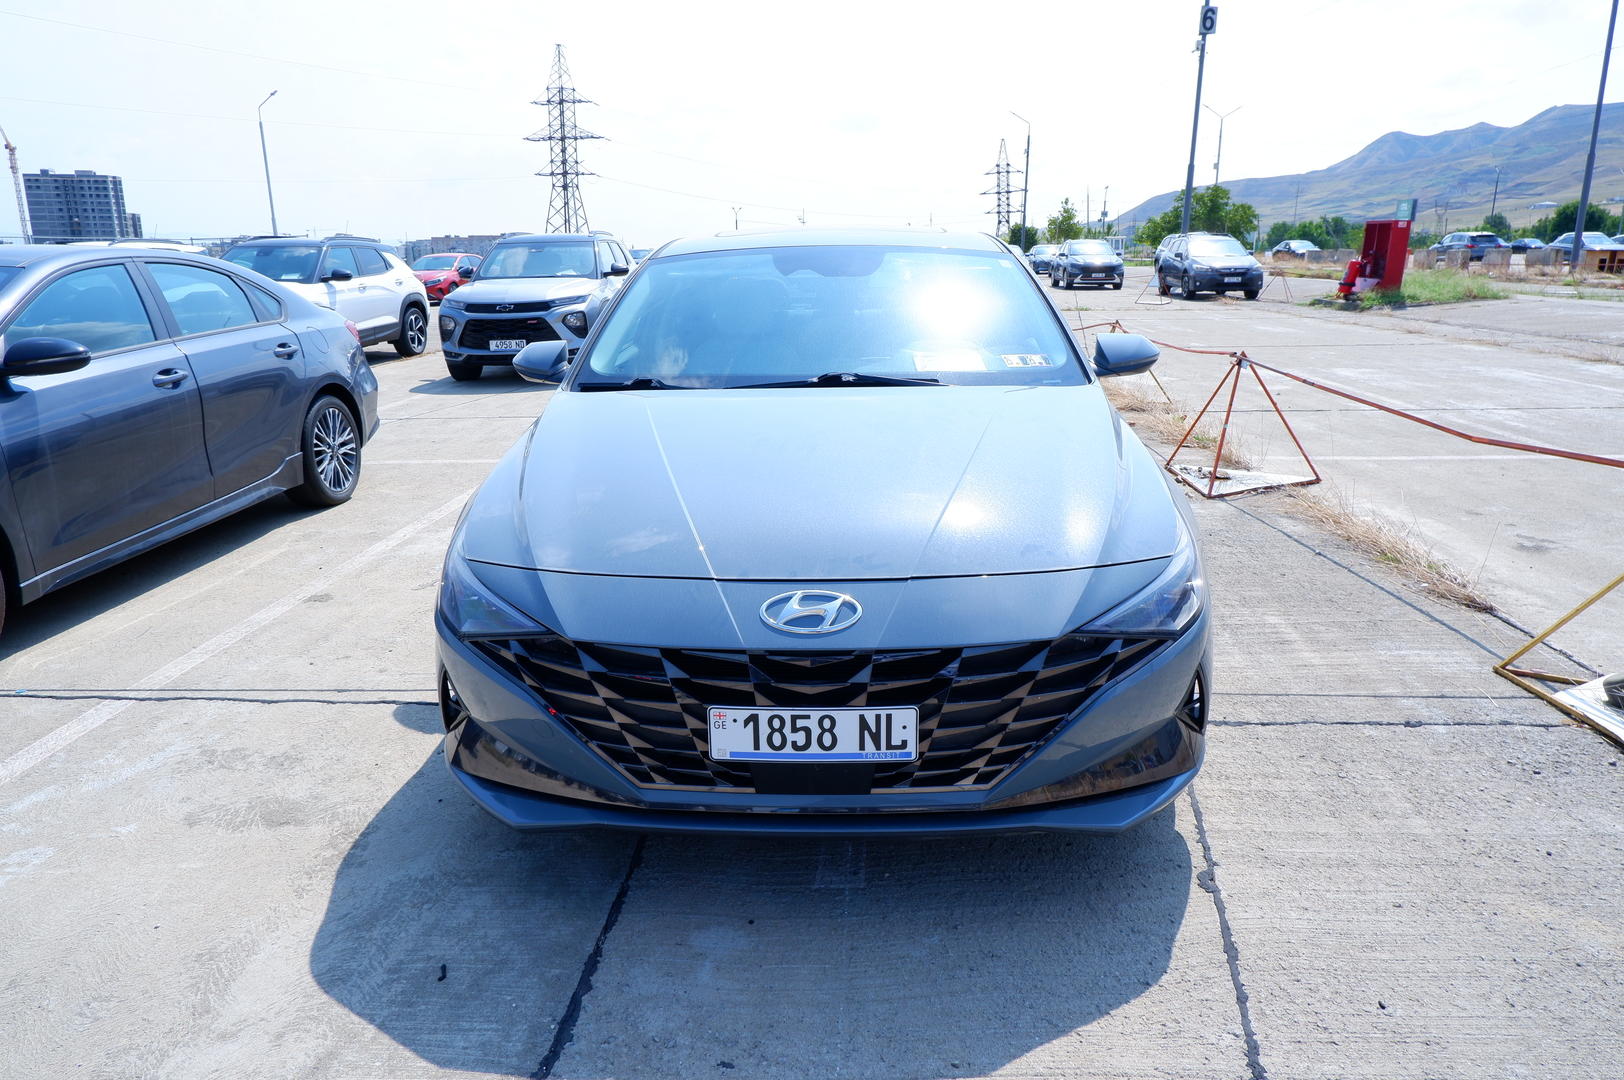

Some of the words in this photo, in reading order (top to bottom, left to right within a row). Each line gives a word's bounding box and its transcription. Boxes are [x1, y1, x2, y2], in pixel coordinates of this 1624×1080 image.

[1202, 8, 1215, 31] 6
[713, 720, 727, 730] GE
[743, 713, 838, 751] 1858
[858, 713, 908, 751] NL
